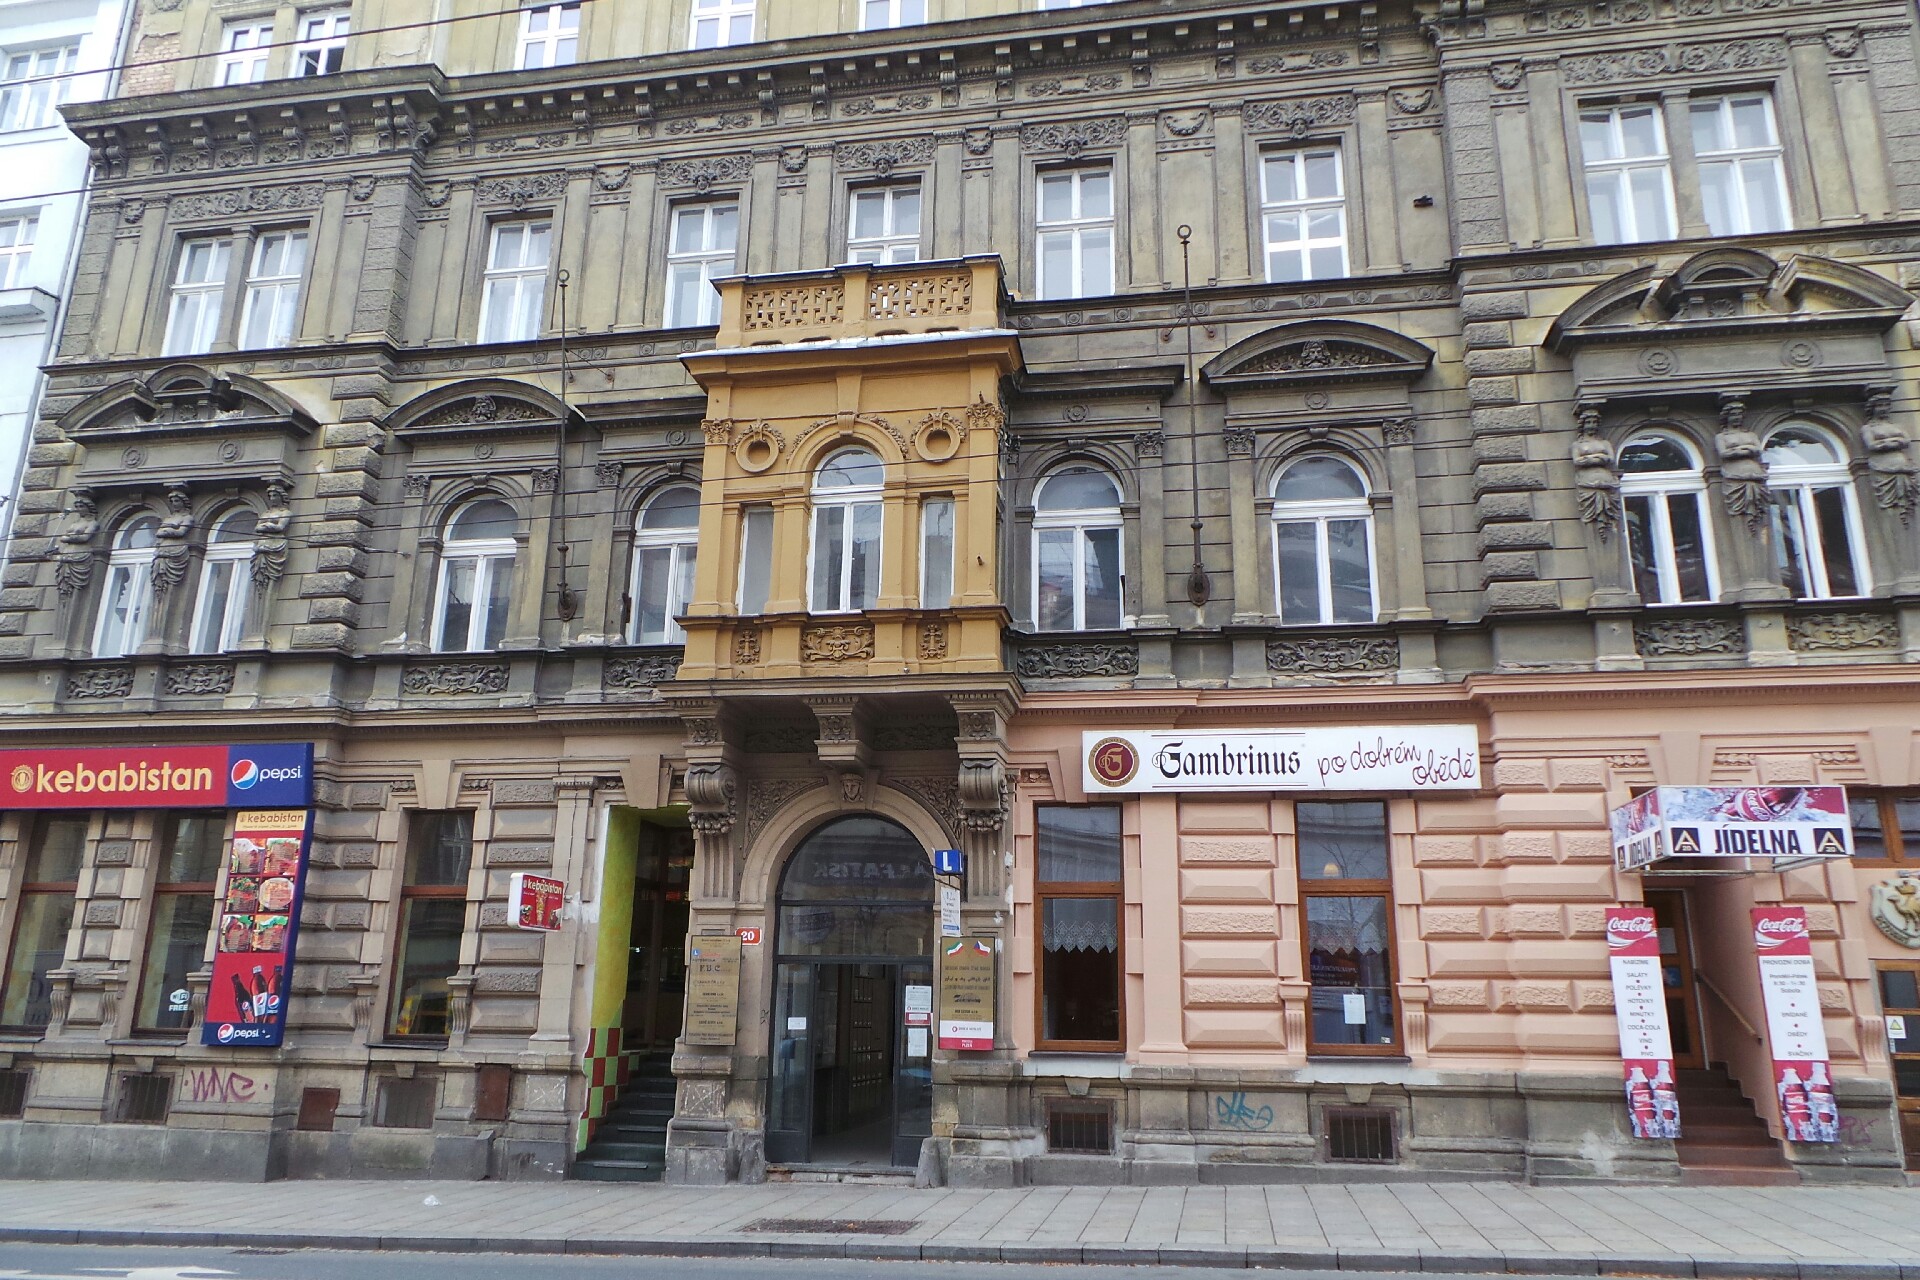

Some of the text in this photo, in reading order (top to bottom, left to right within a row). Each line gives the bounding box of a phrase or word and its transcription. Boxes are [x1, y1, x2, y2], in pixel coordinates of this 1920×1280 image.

[1152, 736, 1421, 787] Gambrinus po dobrém
[1413, 748, 1475, 785] obědě
[36, 761, 212, 793] kebabistan
[259, 766, 301, 782] pepsi
[247, 812, 304, 823] kebabistan
[1714, 824, 1802, 854] JÍDELNA
[942, 851, 953, 871] L
[527, 879, 563, 895] kebabistan
[741, 931, 755, 941] 20
[168, 1004, 189, 1012] FREE
[233, 1029, 260, 1039] pepsi
